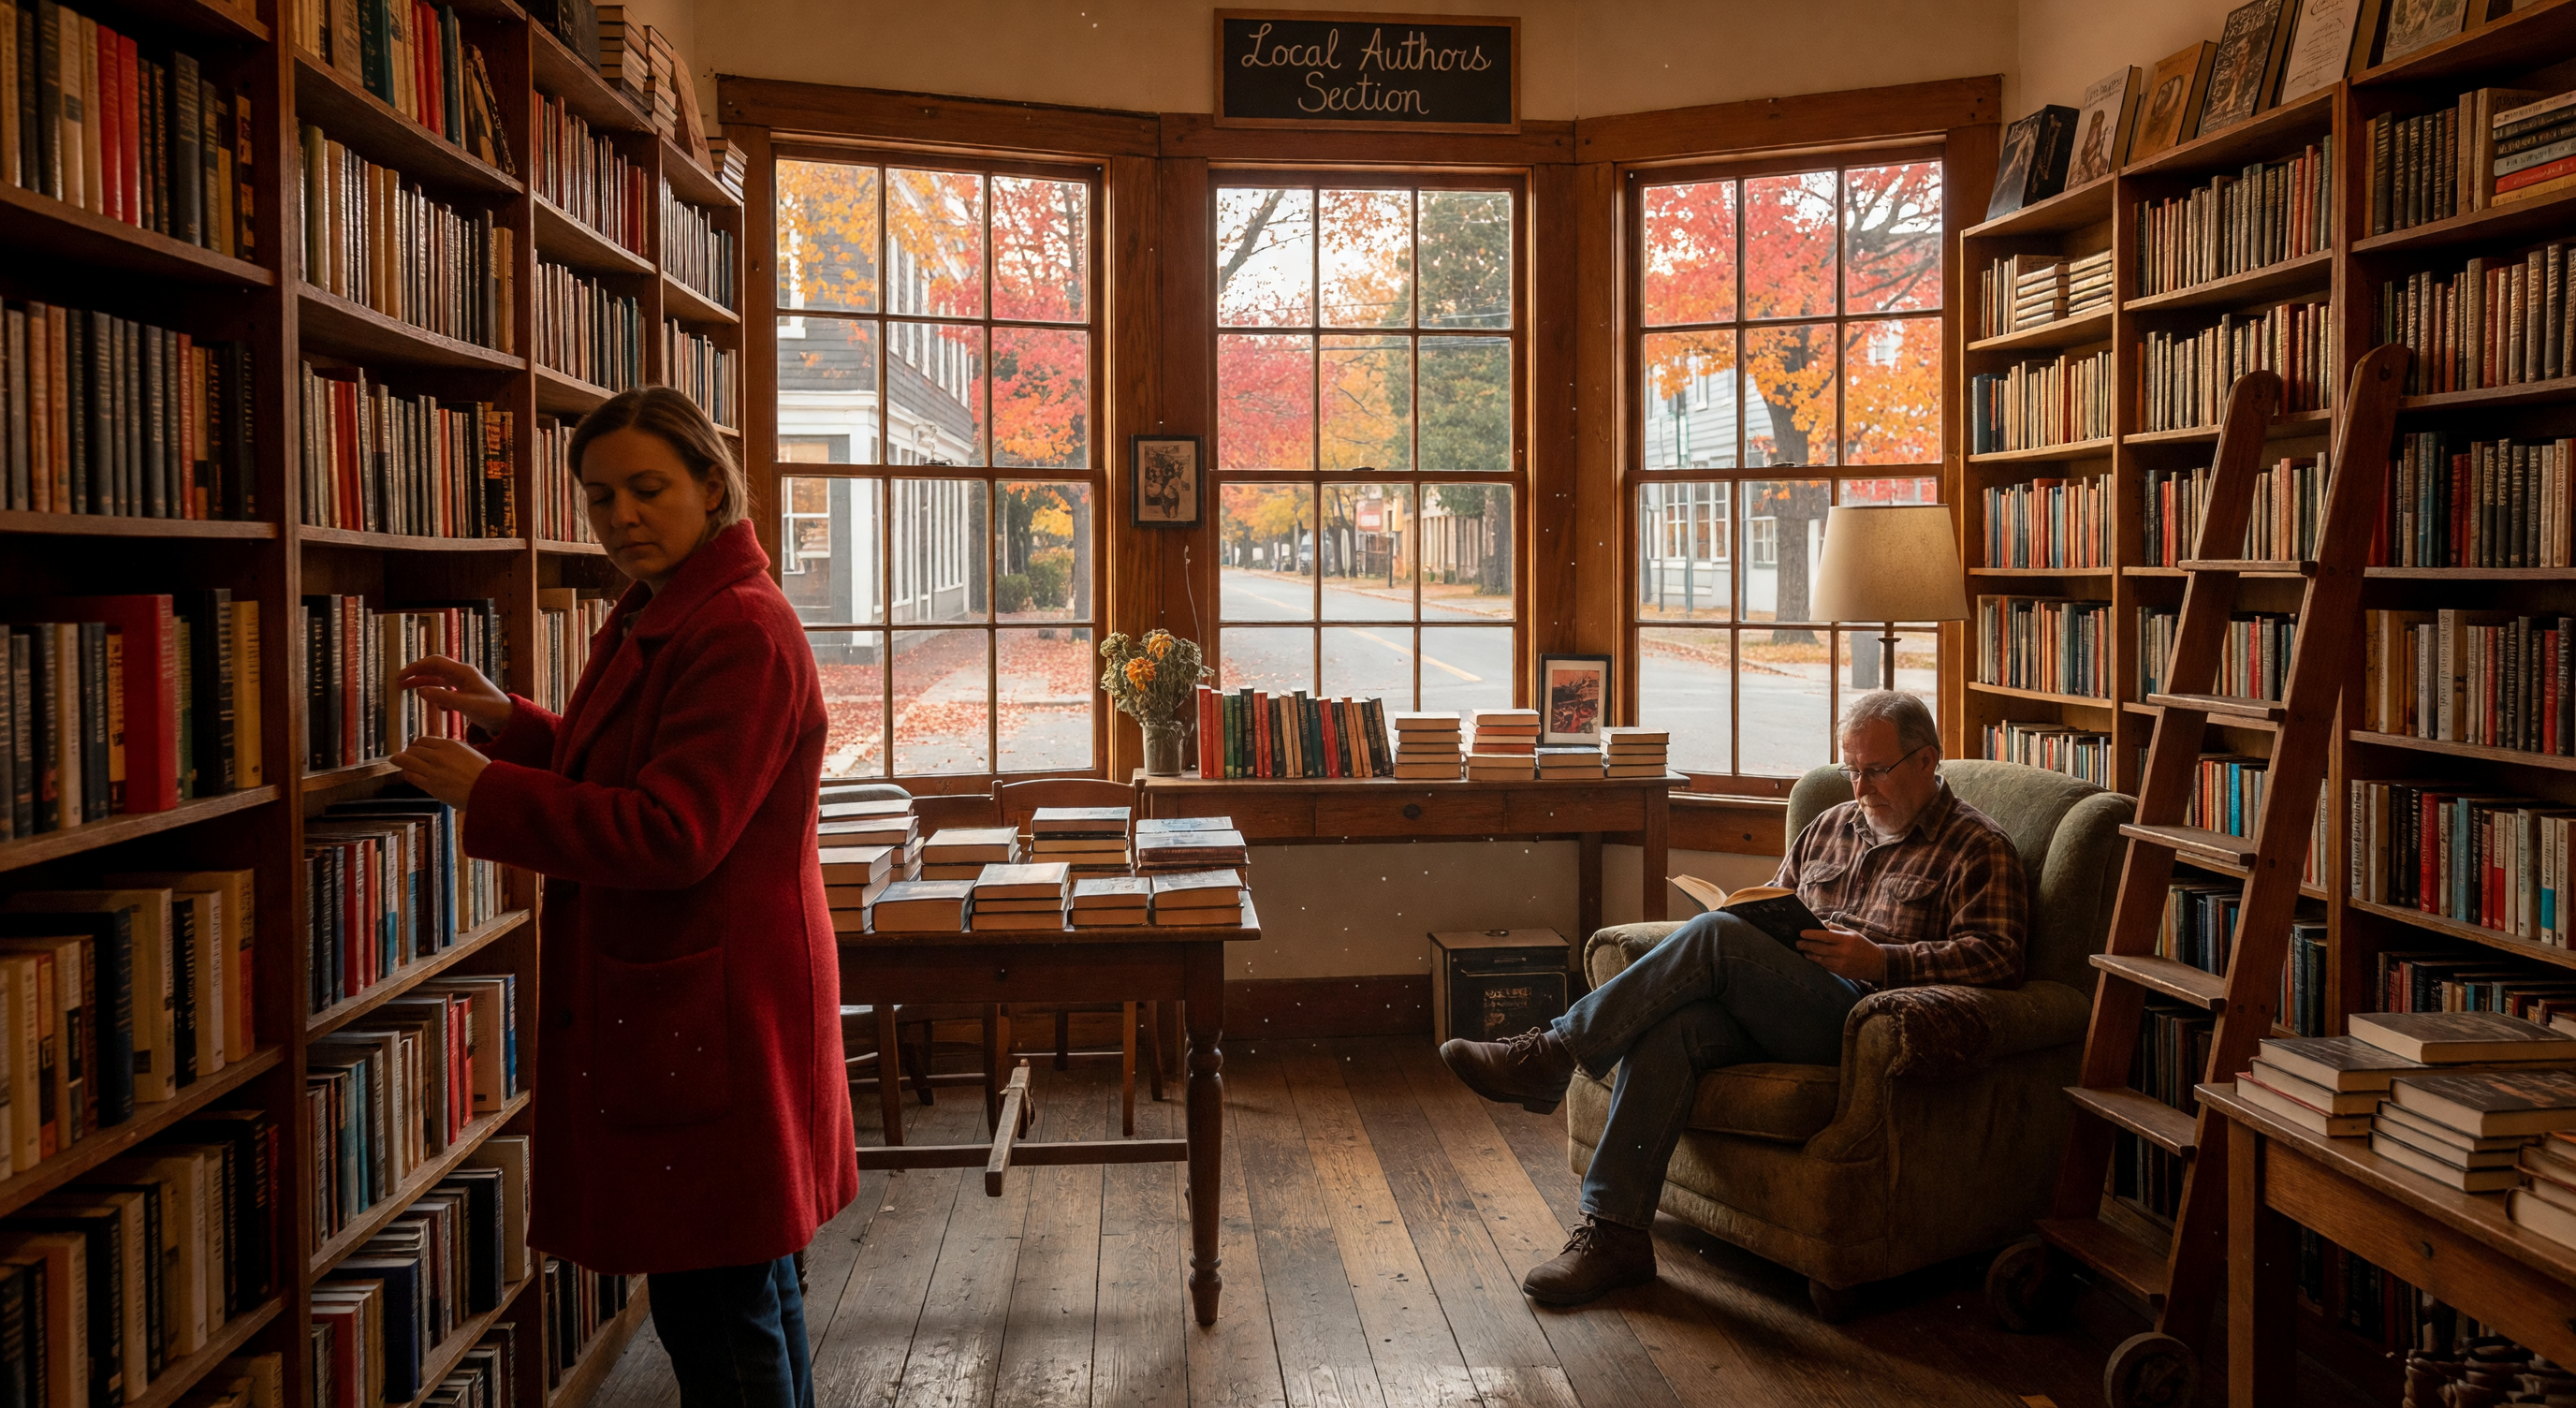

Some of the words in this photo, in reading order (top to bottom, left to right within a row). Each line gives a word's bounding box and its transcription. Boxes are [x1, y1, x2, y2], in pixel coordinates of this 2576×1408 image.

[1241, 22, 1341, 69] Local
[1359, 28, 1491, 71] Authors
[1298, 71, 1429, 114] Section
